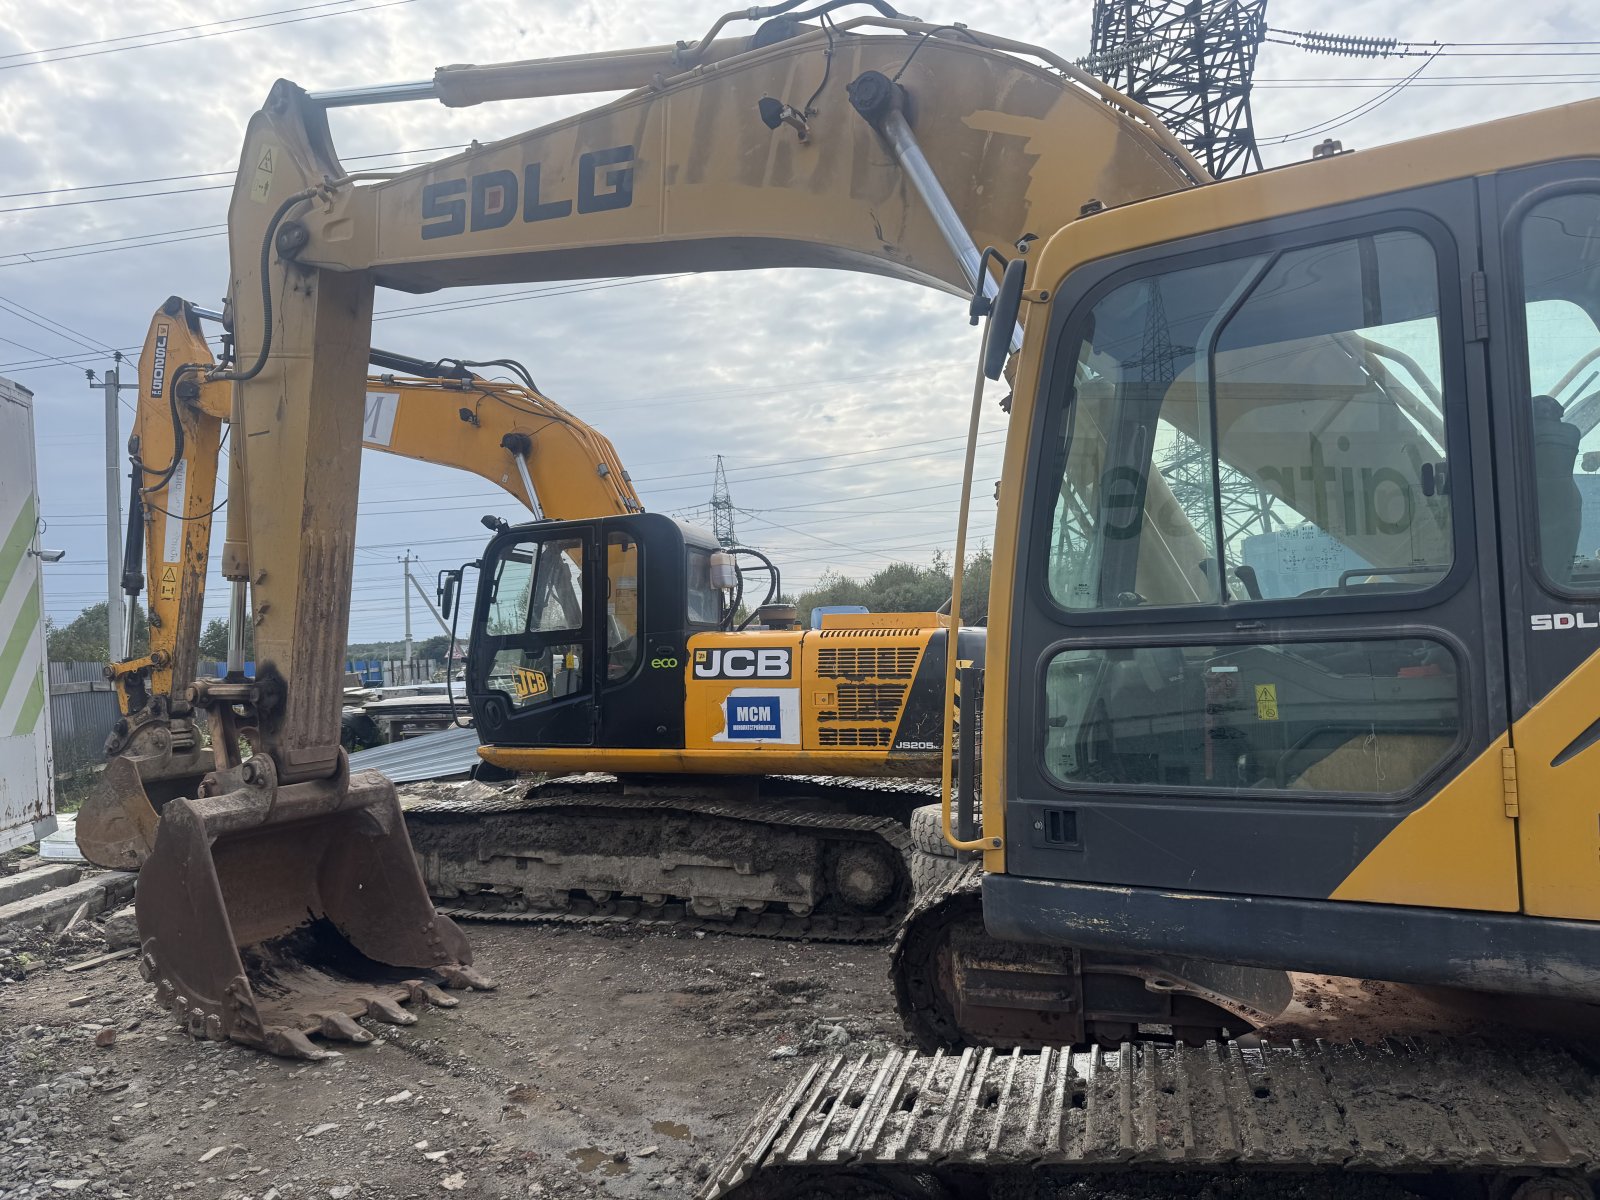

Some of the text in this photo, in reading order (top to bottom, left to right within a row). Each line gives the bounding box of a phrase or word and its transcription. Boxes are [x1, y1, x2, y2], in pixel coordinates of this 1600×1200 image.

[421, 144, 635, 240] SDLG
[152, 337, 167, 390] JS205
[1530, 611, 1600, 631] SDL
[651, 657, 678, 669] eco
[695, 649, 790, 677] JCB
[516, 668, 547, 696] JCB
[895, 741, 934, 749] JS205
